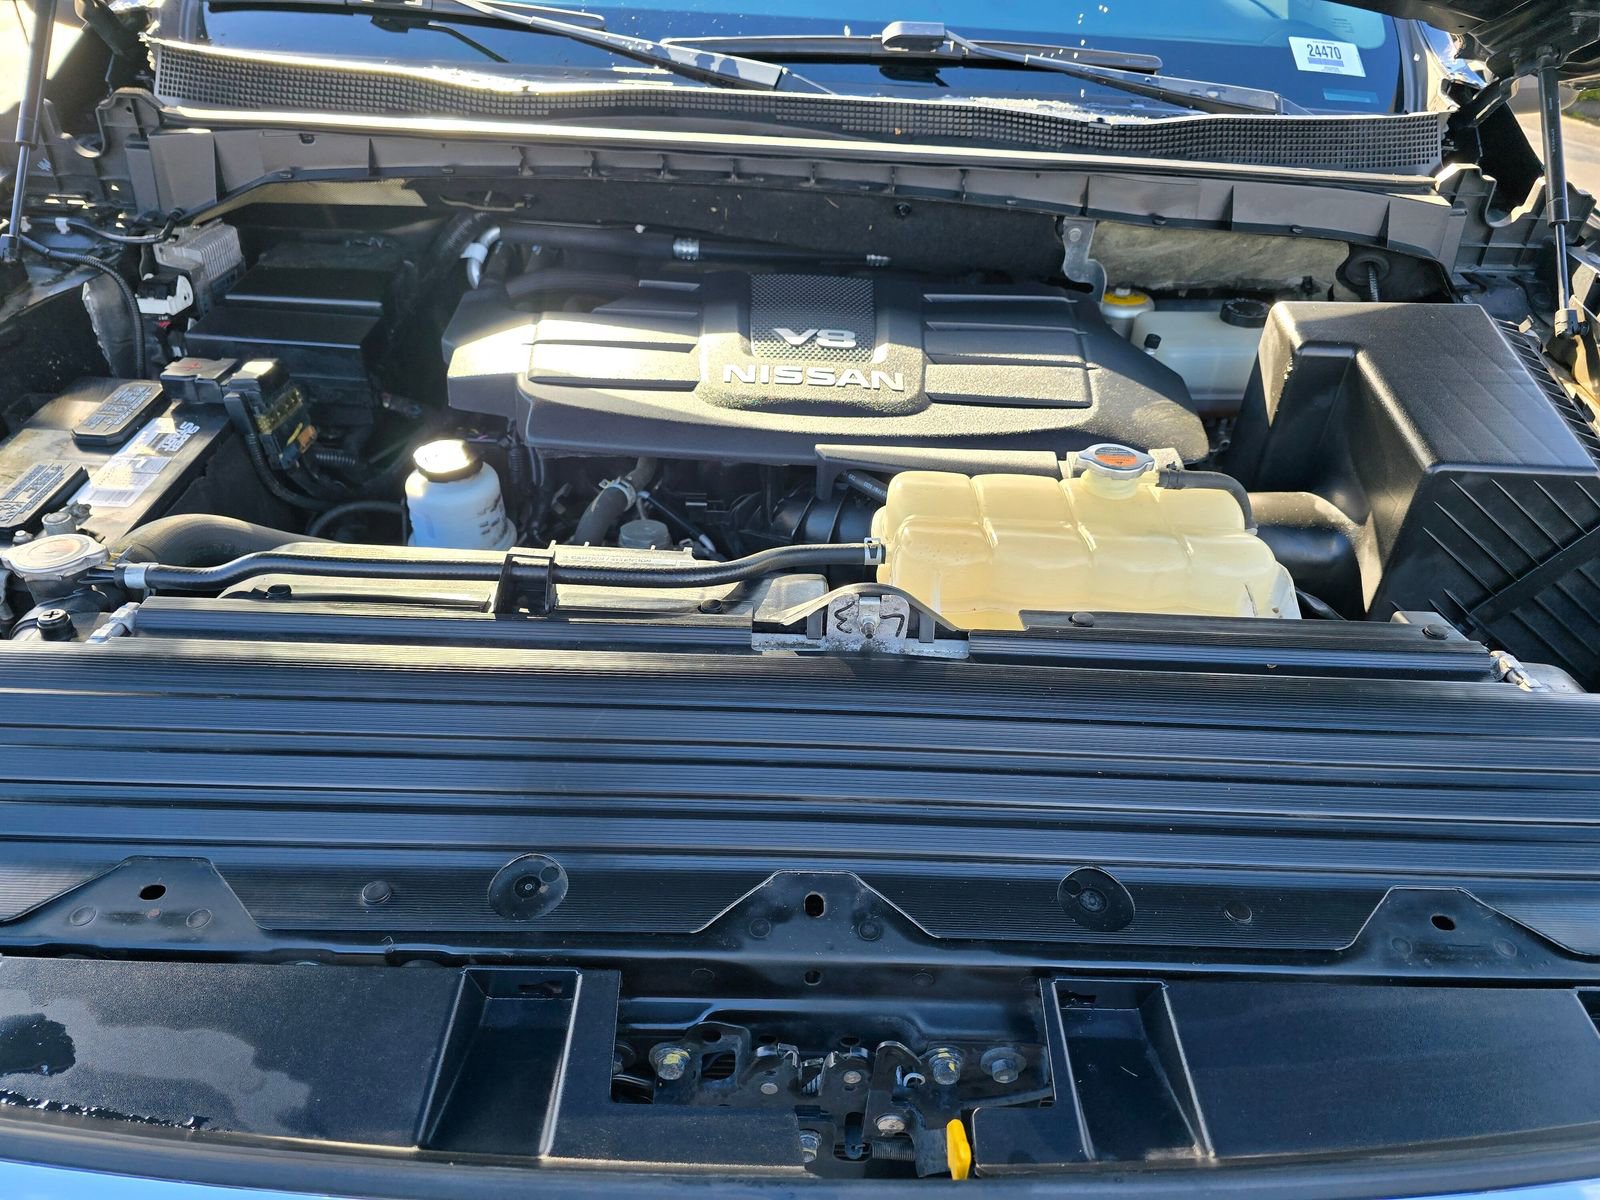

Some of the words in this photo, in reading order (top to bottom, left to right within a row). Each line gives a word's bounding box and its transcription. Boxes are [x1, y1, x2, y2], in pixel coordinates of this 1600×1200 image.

[1306, 43, 1342, 59] 24470
[772, 327, 857, 349] V8
[724, 364, 905, 391] NISSAN
